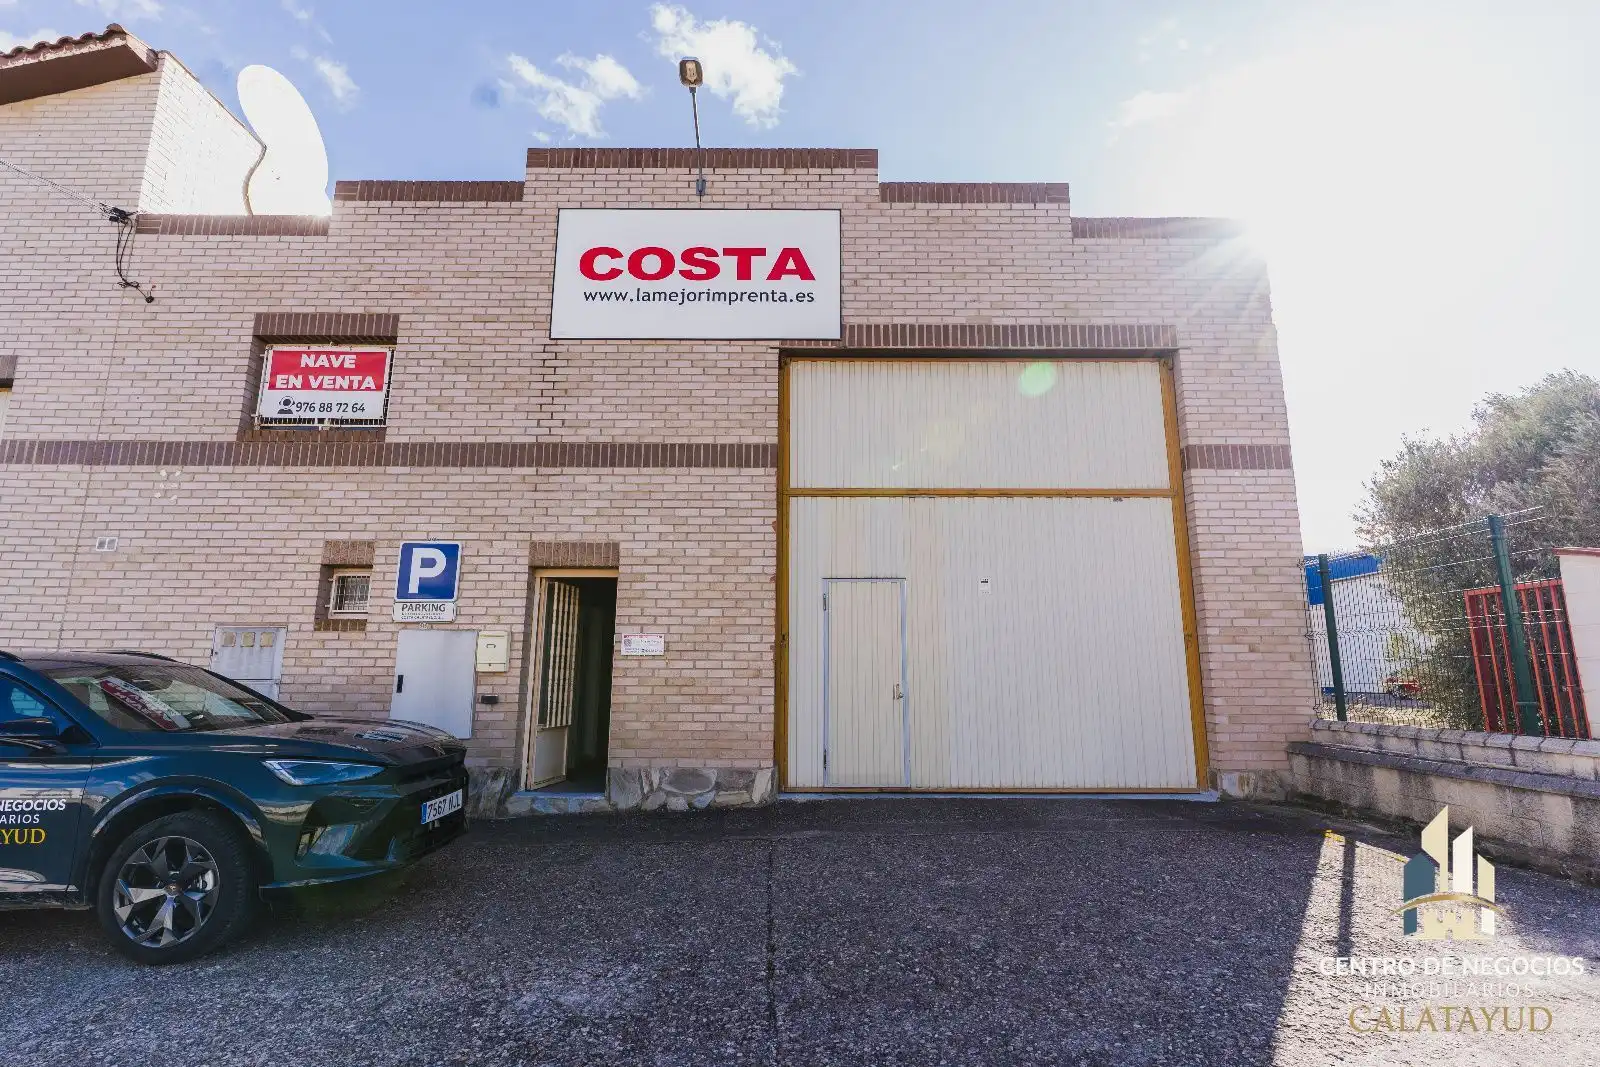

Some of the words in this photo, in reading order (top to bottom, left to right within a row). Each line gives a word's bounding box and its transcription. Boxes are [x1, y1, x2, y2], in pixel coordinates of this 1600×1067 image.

[579, 246, 816, 281] COSTA
[583, 288, 815, 305] www.lamejorimprenta.es
[300, 354, 357, 369] NAVE
[275, 374, 303, 389] EN
[308, 375, 376, 390] VENTA
[295, 402, 316, 413] 976
[319, 402, 333, 413] 88
[336, 403, 348, 413] 72
[351, 403, 365, 413] 64
[408, 547, 447, 594] P
[401, 603, 446, 612] PARKING
[427, 799, 447, 820] 7567
[0, 828, 46, 845] YUD
